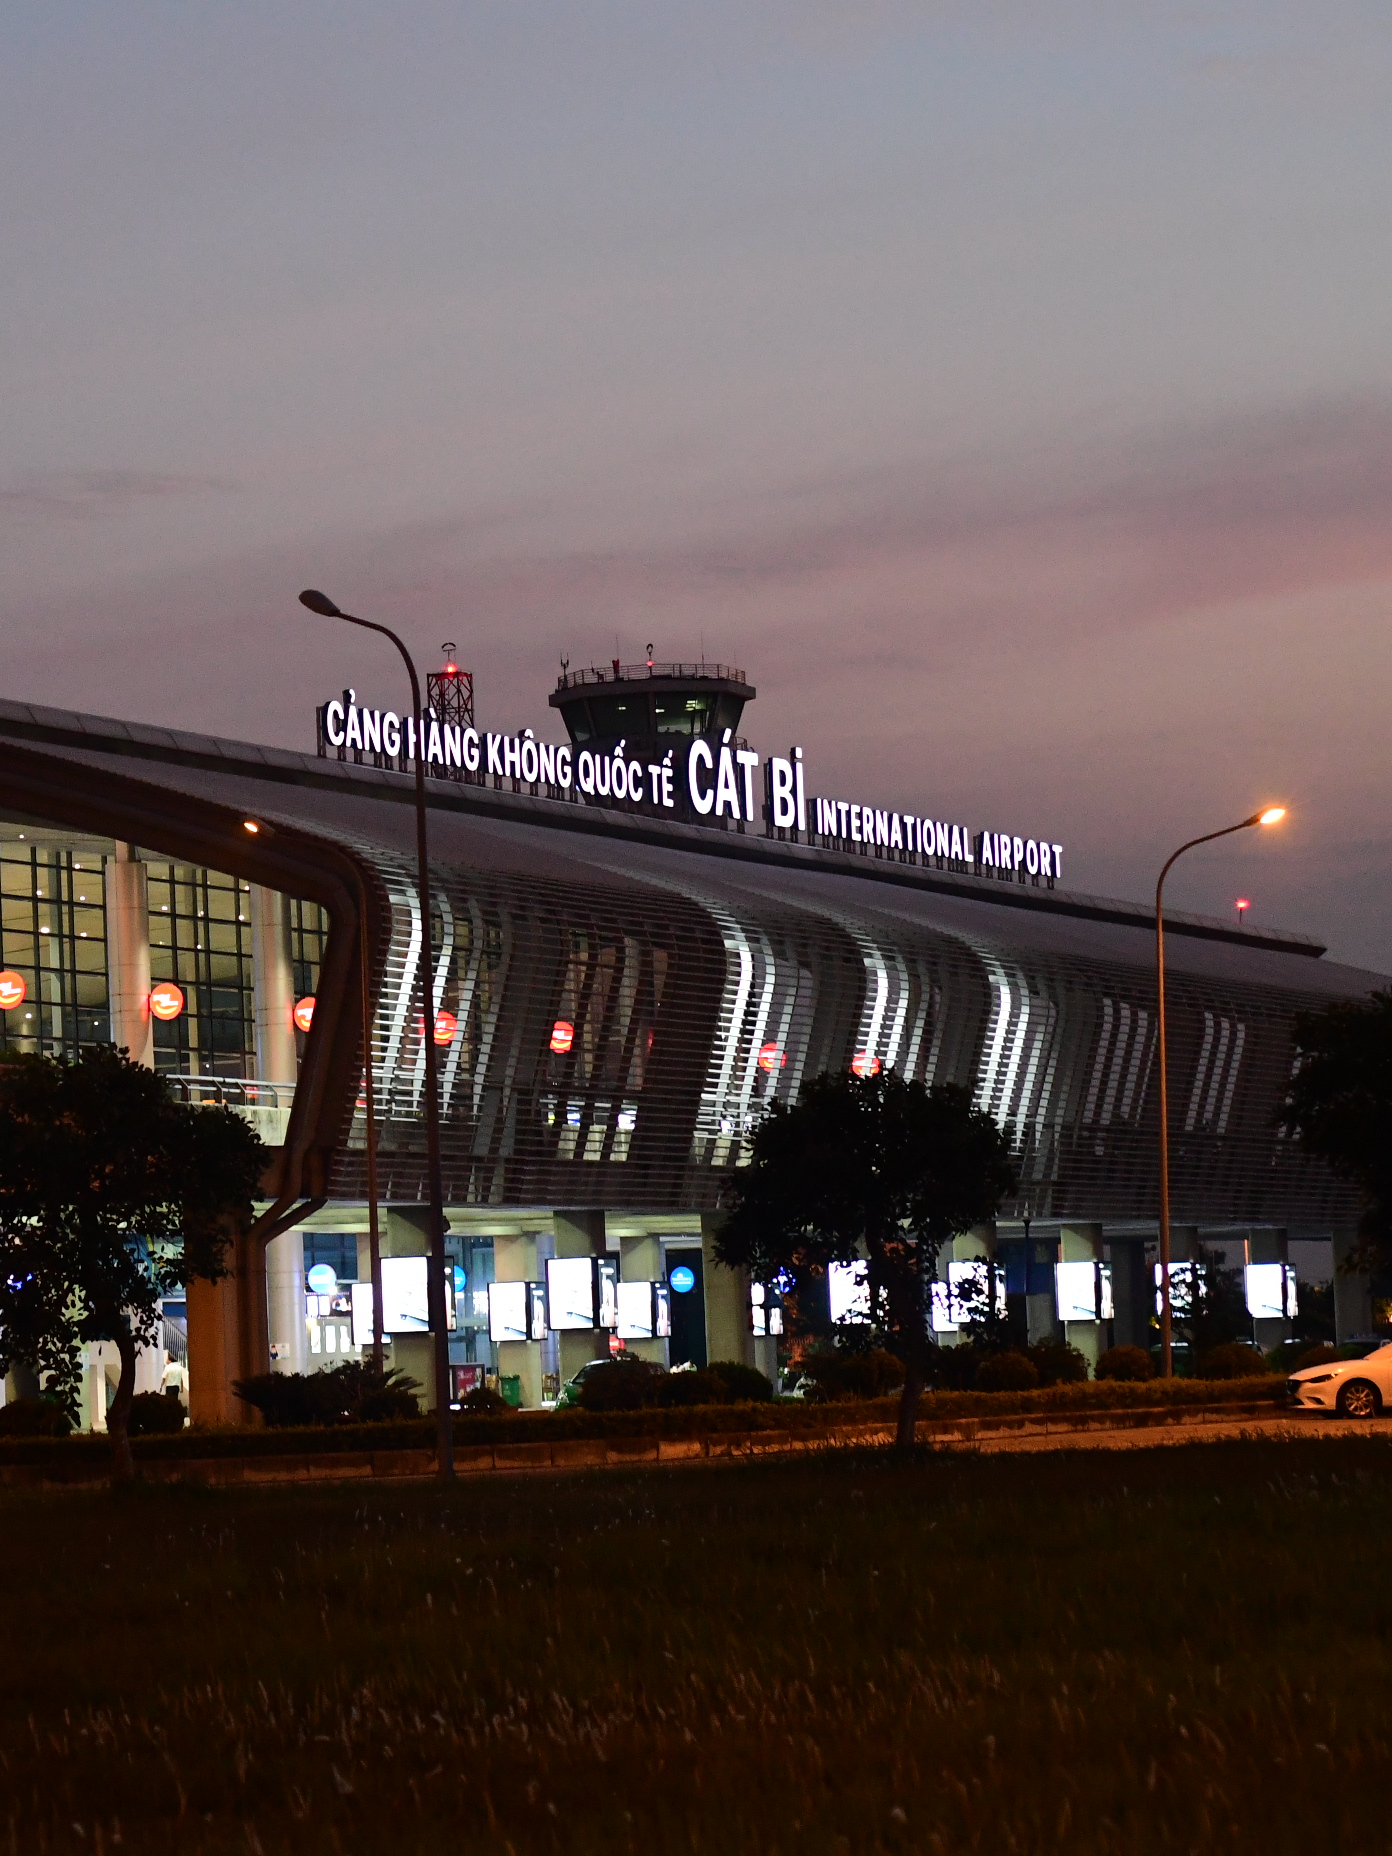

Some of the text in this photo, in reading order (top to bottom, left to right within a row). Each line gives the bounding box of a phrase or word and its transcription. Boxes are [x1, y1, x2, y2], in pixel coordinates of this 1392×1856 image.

[326, 688, 401, 757] CẢNG
[407, 707, 480, 772] HÀNG
[486, 728, 572, 789] KHÔNG
[578, 739, 643, 802] QUỐC
[647, 749, 674, 808] TẾ
[688, 727, 759, 822] CÁT
[816, 797, 974, 863] INTERNATIONAL
[982, 830, 1063, 879] AIRPORT
